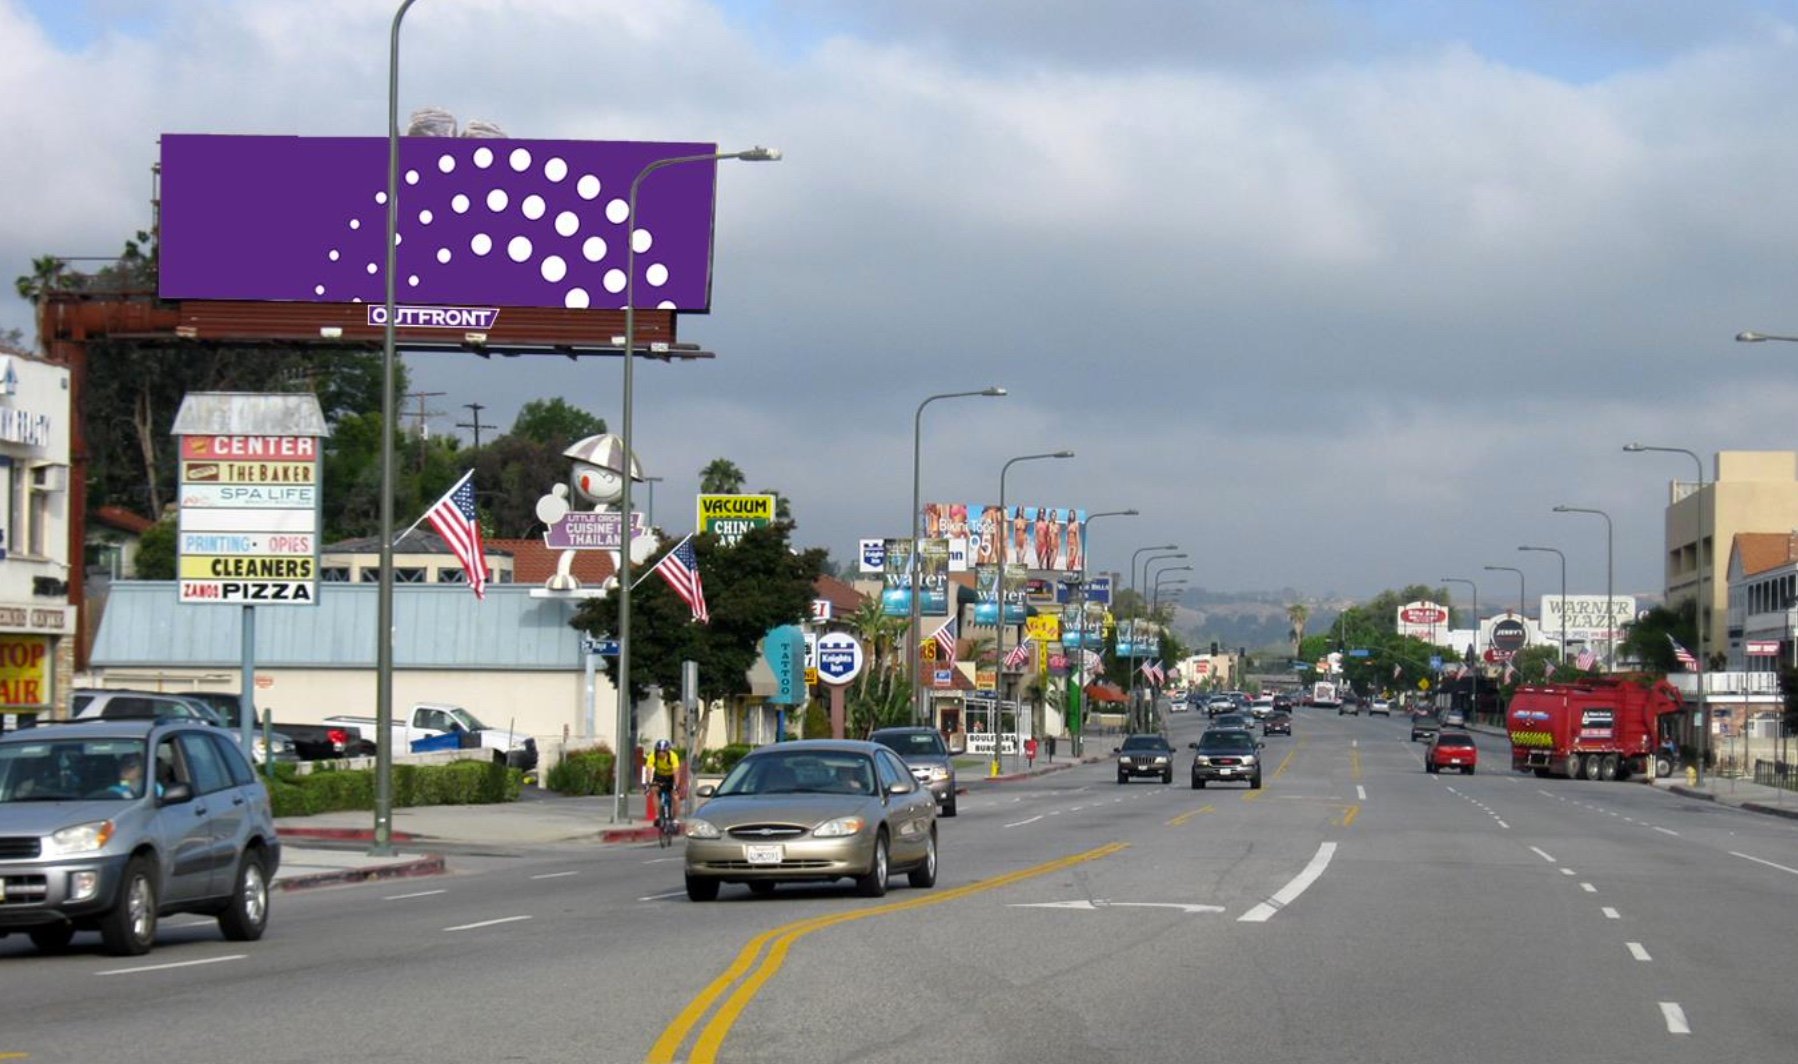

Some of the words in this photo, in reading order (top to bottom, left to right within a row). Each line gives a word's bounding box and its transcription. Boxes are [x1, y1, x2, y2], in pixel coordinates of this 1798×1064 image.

[214, 437, 313, 455] CENTER
[227, 464, 254, 482] THE
[259, 464, 311, 482] BAKER
[220, 488, 261, 500] SPA
[268, 488, 312, 500] LIFE
[703, 499, 767, 513] VACUUM
[567, 514, 594, 523] LITTLE
[566, 523, 614, 533] CUISINE
[714, 520, 757, 534] CHINA
[185, 536, 251, 553] PRINTING
[568, 534, 622, 545] THAILAN
[211, 558, 311, 578] CLEANERS
[886, 572, 947, 588] water
[222, 583, 311, 600] PIZZA
[1559, 614, 1620, 629] PLAZA
[821, 653, 853, 664] Knights
[780, 642, 791, 695] TATTOO
[829, 663, 845, 674] Inn
[969, 734, 1016, 742] BOULEARD
